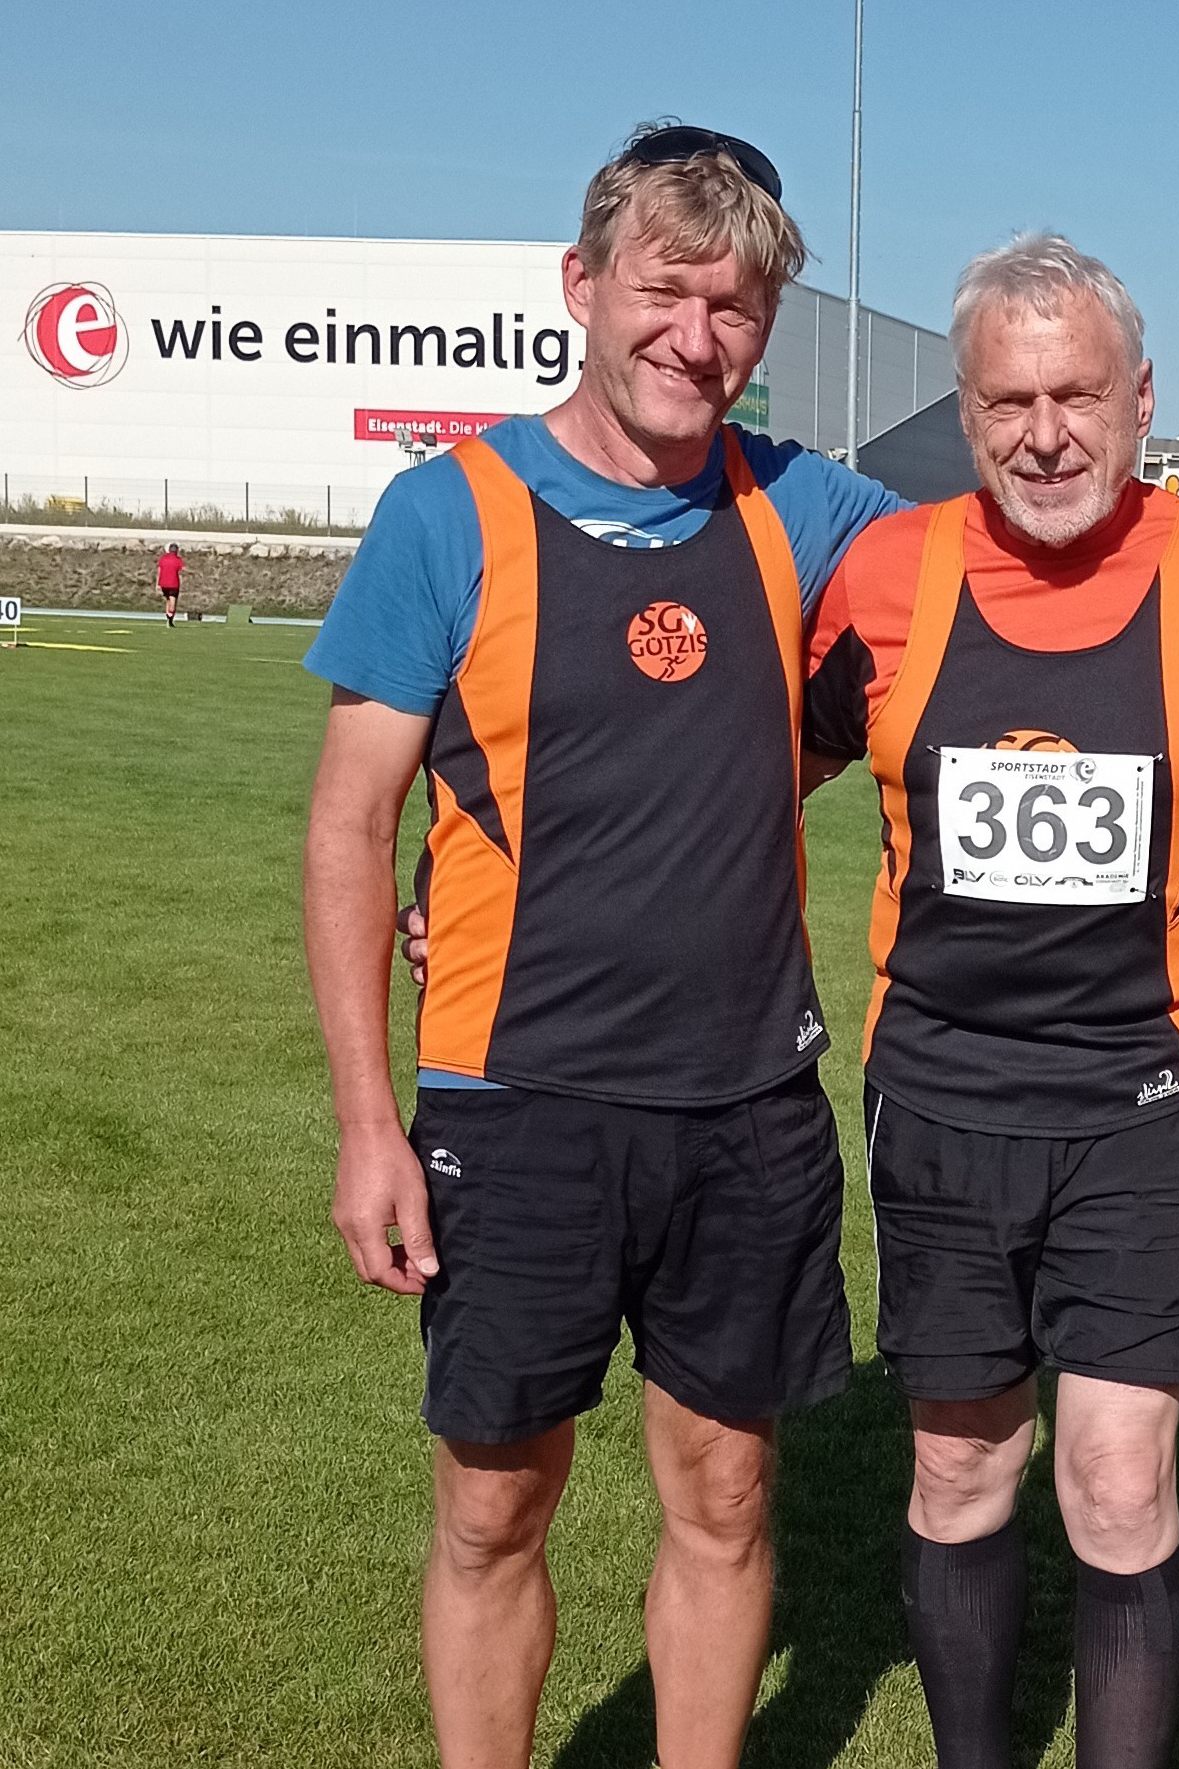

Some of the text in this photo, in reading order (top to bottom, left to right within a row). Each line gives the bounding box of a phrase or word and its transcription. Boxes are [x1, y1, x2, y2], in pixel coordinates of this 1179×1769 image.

[150, 305, 262, 360] wie
[450, 421, 472, 435] Die
[638, 604, 683, 636] SG
[990, 761, 1067, 774] SPORTSTADT
[958, 781, 1127, 864] 363
